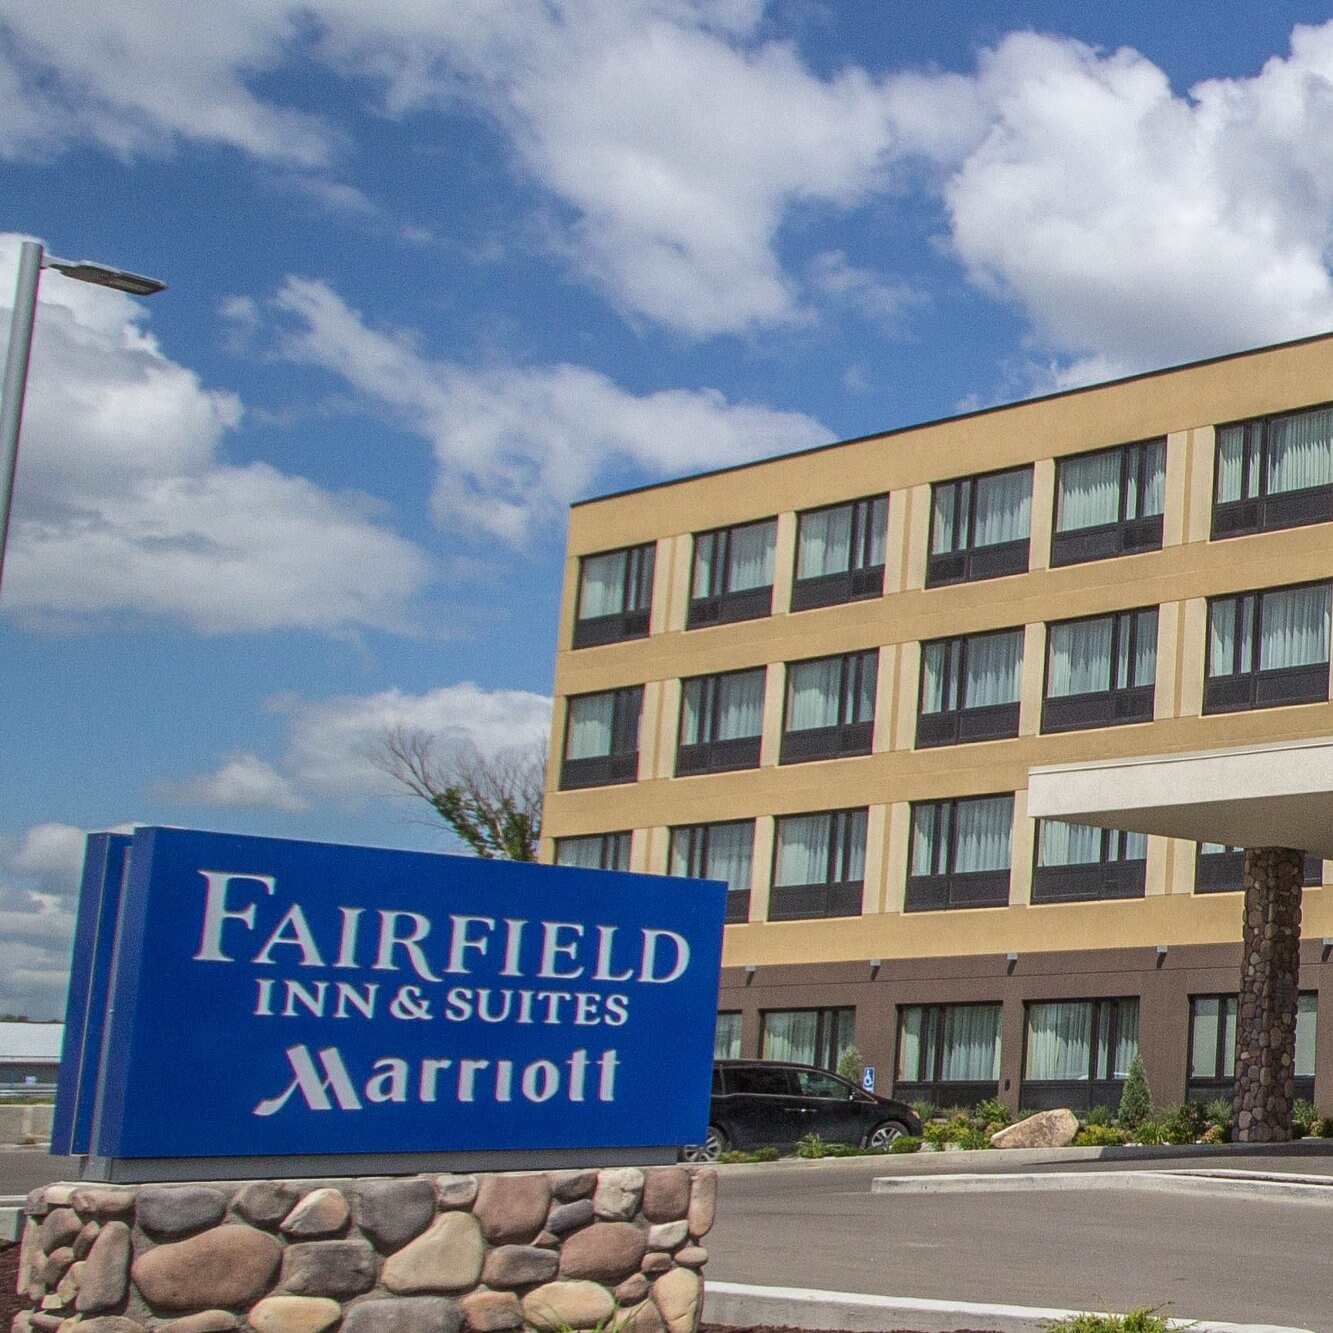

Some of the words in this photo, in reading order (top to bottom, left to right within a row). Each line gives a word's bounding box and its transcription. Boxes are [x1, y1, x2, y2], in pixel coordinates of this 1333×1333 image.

[192, 868, 691, 984] FAIRFIELD
[254, 978, 380, 1019] INN
[388, 985, 434, 1021] &
[444, 987, 630, 1027] SUITES
[252, 1043, 621, 1117] Marriott
